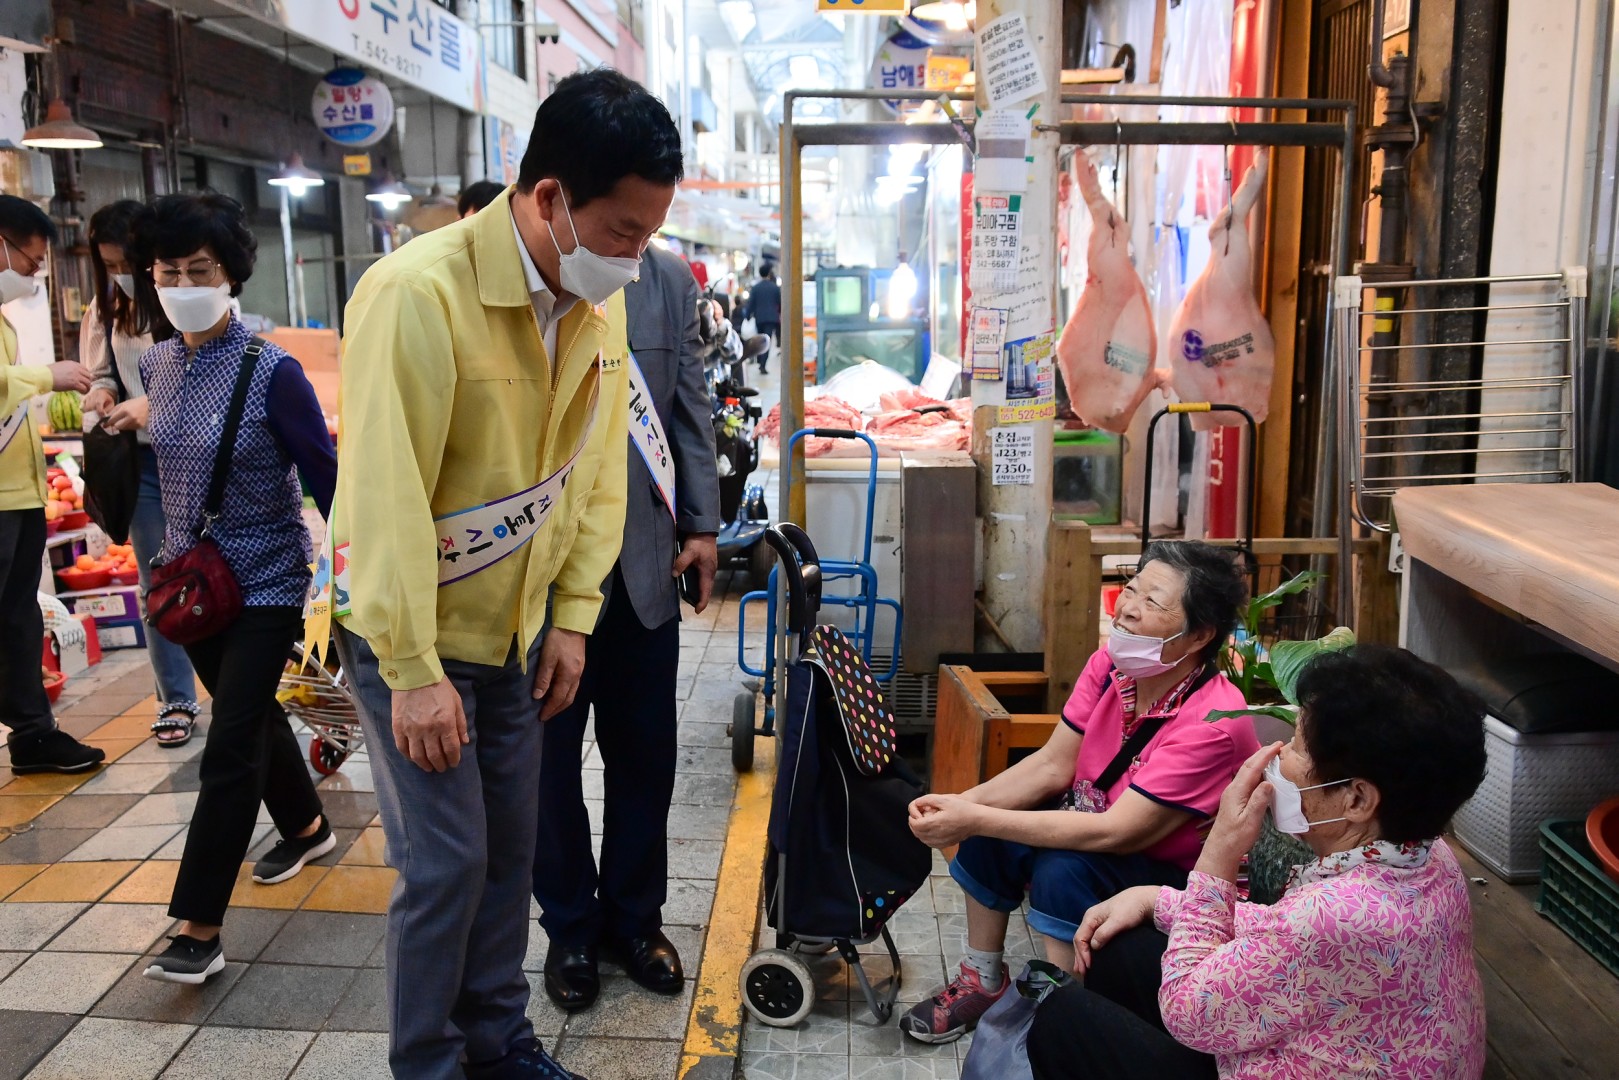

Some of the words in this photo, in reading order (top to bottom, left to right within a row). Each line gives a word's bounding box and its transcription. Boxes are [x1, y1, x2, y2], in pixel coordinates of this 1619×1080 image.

[338, 0, 461, 71] 수산물
[882, 64, 915, 88] 남해
[323, 104, 374, 122] 수산물
[1000, 235, 1017, 248] 구함
